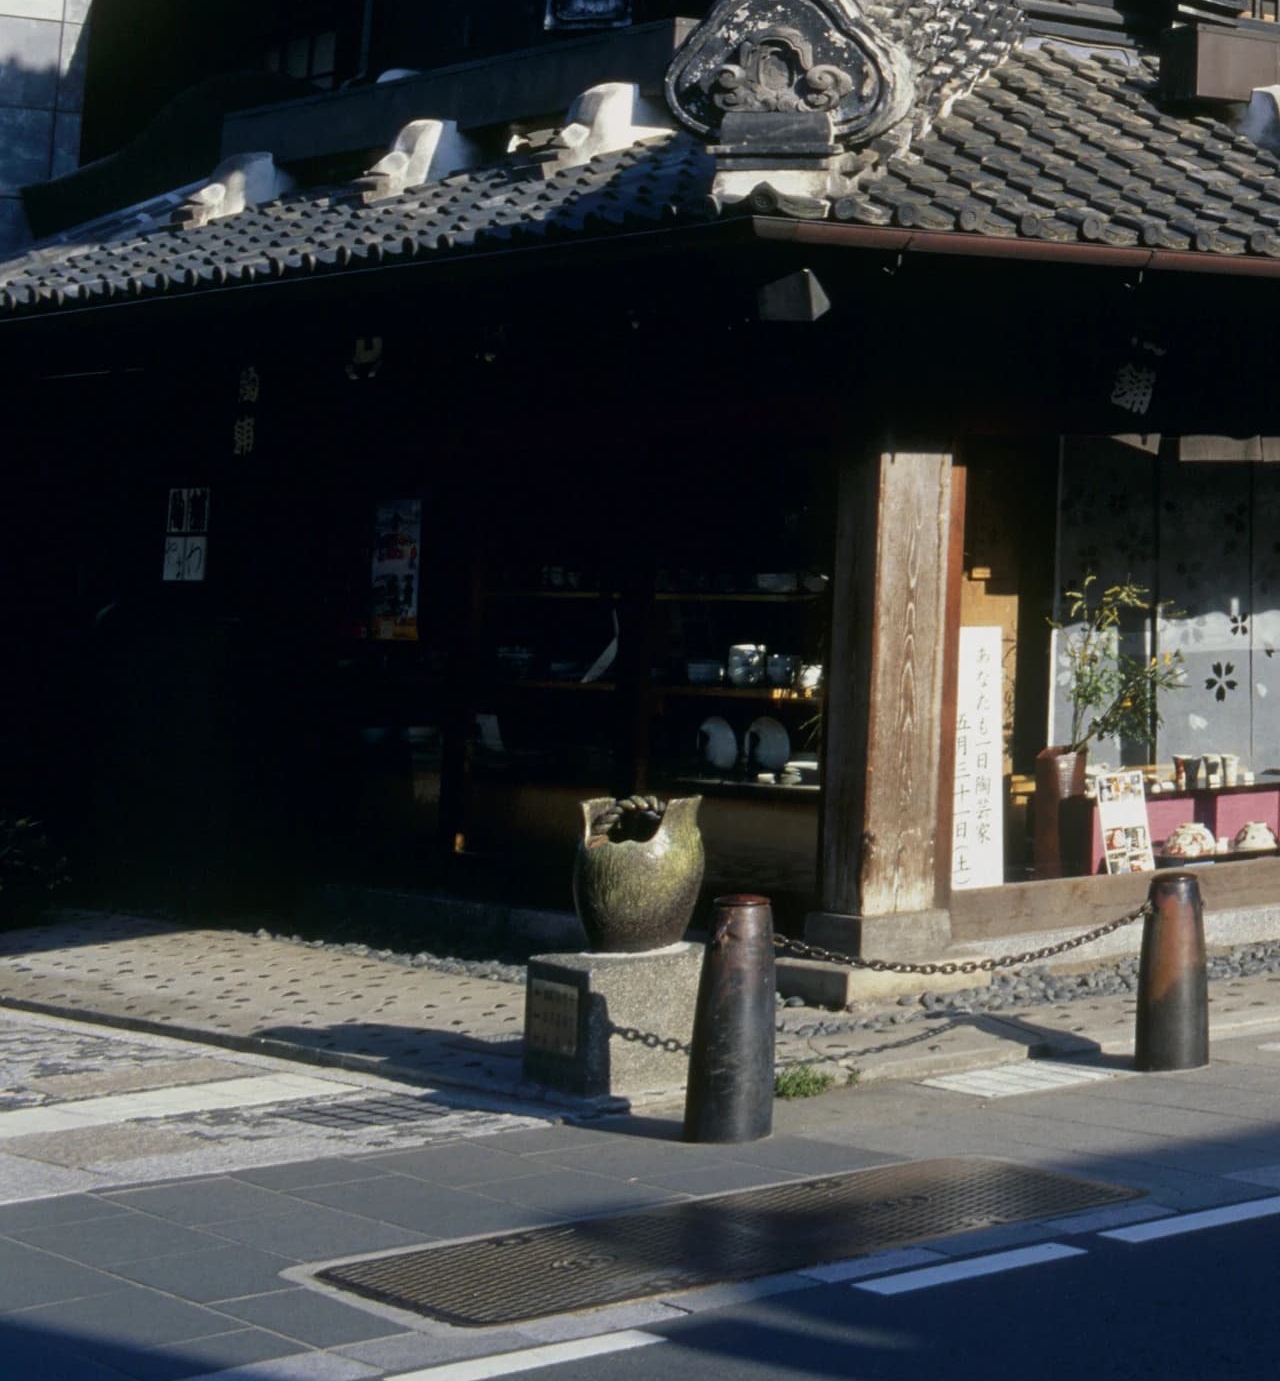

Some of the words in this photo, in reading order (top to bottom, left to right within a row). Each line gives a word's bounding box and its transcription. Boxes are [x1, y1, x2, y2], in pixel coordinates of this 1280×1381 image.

[974, 647, 992, 844] あなたも一日陶芸家
